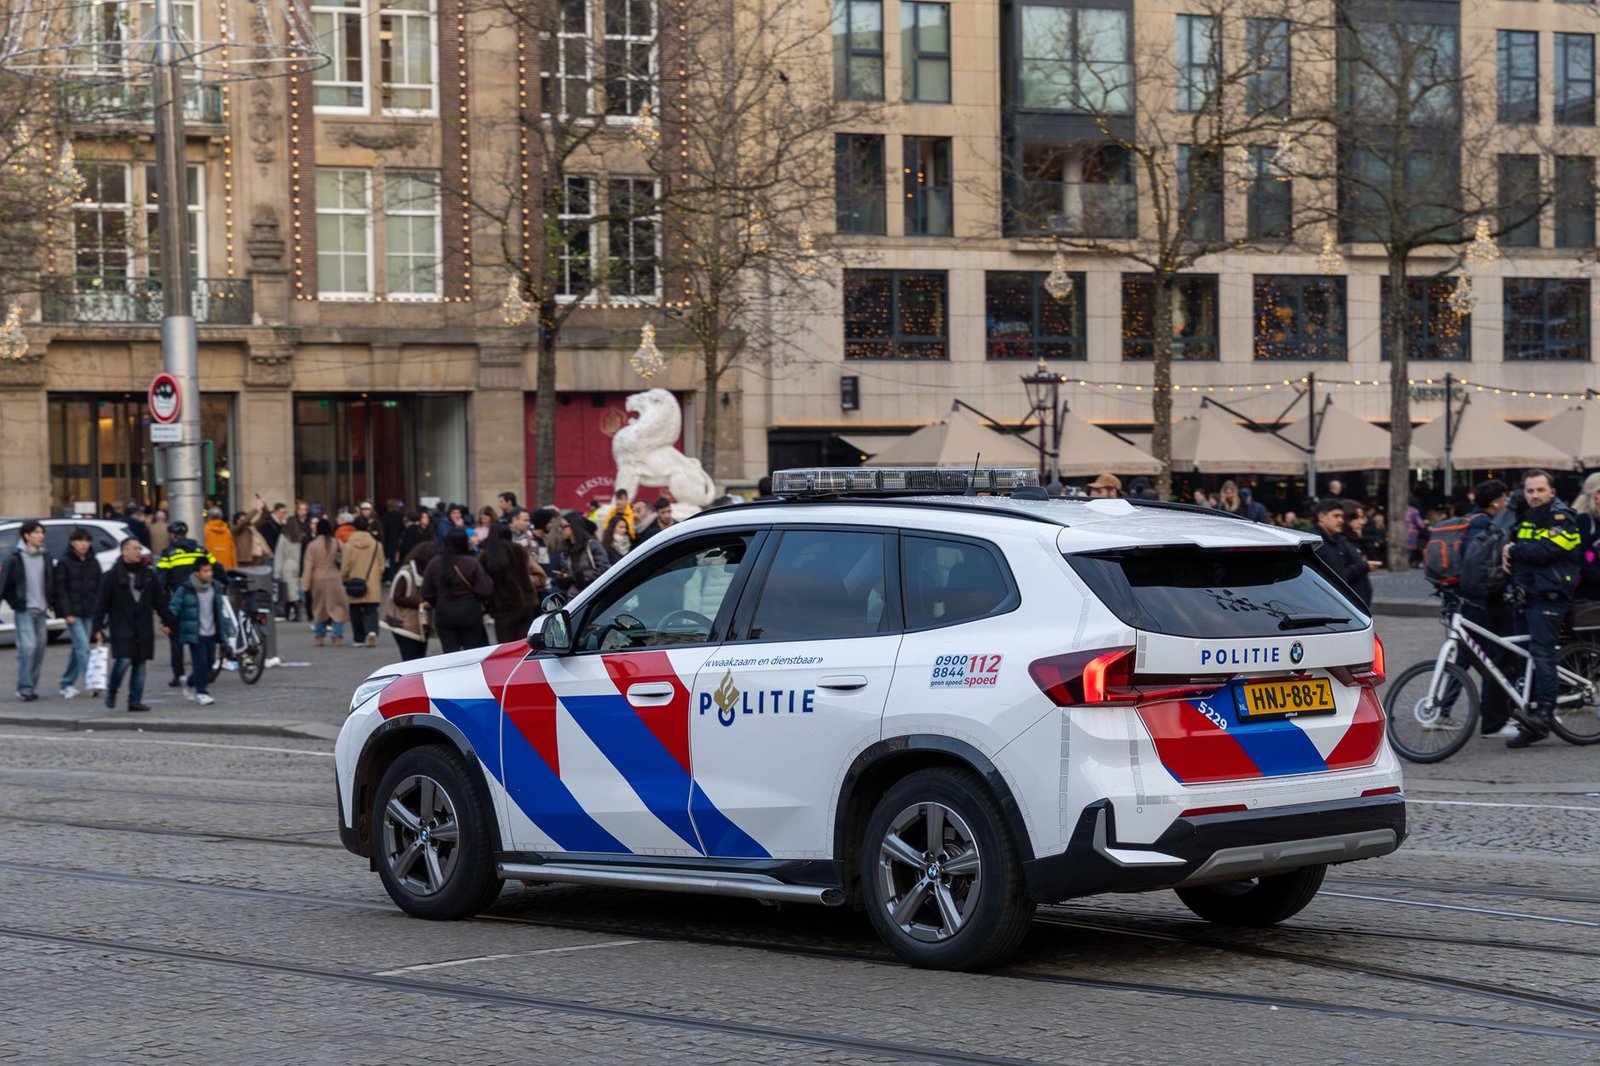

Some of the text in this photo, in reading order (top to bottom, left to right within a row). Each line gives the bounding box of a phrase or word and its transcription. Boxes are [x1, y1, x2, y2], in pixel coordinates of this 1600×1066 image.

[758, 658, 769, 666] en
[935, 655, 1002, 673] 0900 112
[1201, 647, 1279, 665] POLITIE
[932, 667, 964, 678] 8844
[963, 675, 997, 688] spoed
[1251, 683, 1328, 710] HNJ-88-Z
[699, 689, 815, 727] POLITIE
[1197, 701, 1228, 730] 5229
[1238, 703, 1248, 711] NL
